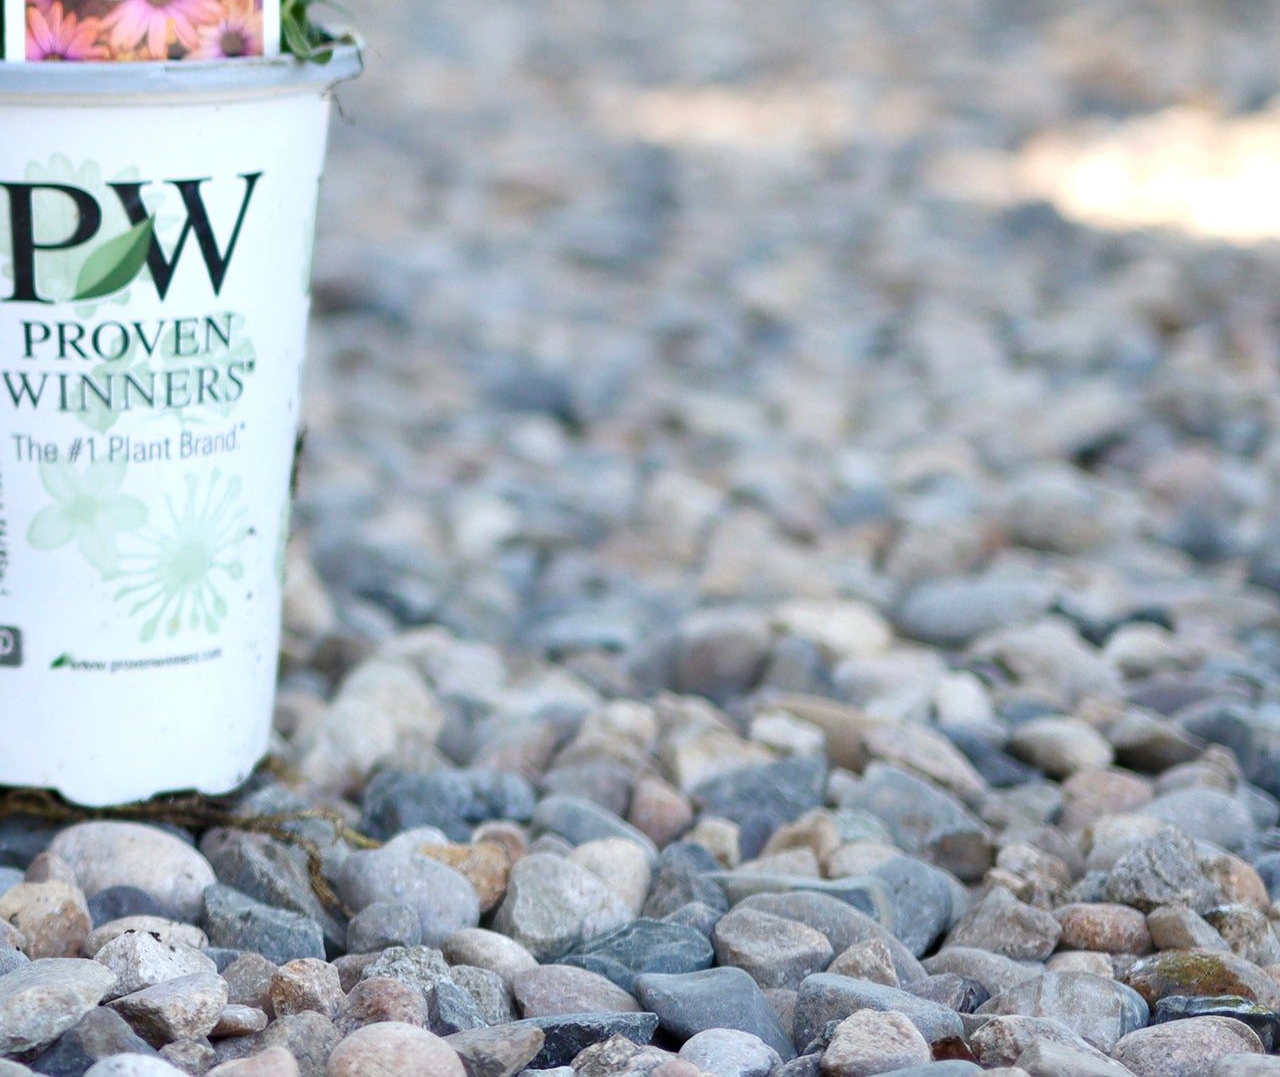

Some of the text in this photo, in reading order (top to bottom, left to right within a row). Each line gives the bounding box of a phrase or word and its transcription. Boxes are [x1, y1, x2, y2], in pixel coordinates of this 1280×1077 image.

[20, 313, 237, 361] PROVEN
[12, 434, 59, 464] The
[67, 436, 97, 464] #1
[107, 434, 171, 463] Plant
